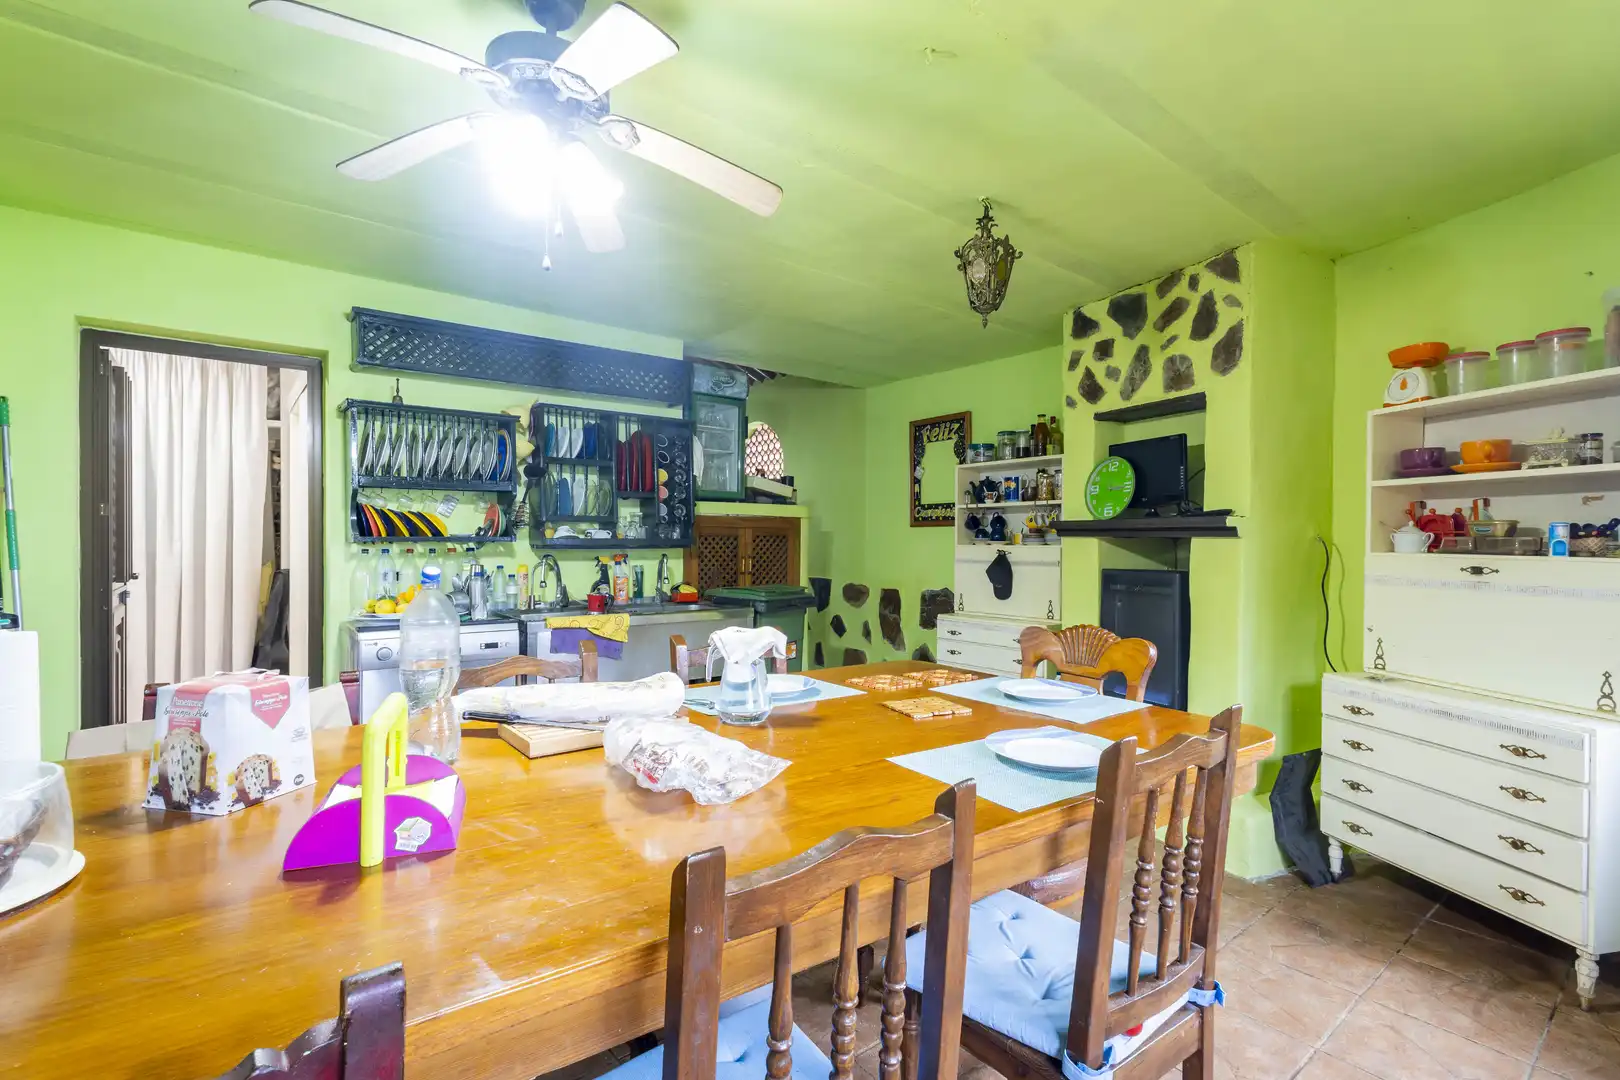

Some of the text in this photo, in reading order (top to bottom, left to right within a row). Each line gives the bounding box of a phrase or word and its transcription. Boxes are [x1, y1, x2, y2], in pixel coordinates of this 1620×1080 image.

[921, 422, 960, 445] Feliz
[1108, 461, 1119, 472] 12
[1103, 506, 1113, 517] 6
